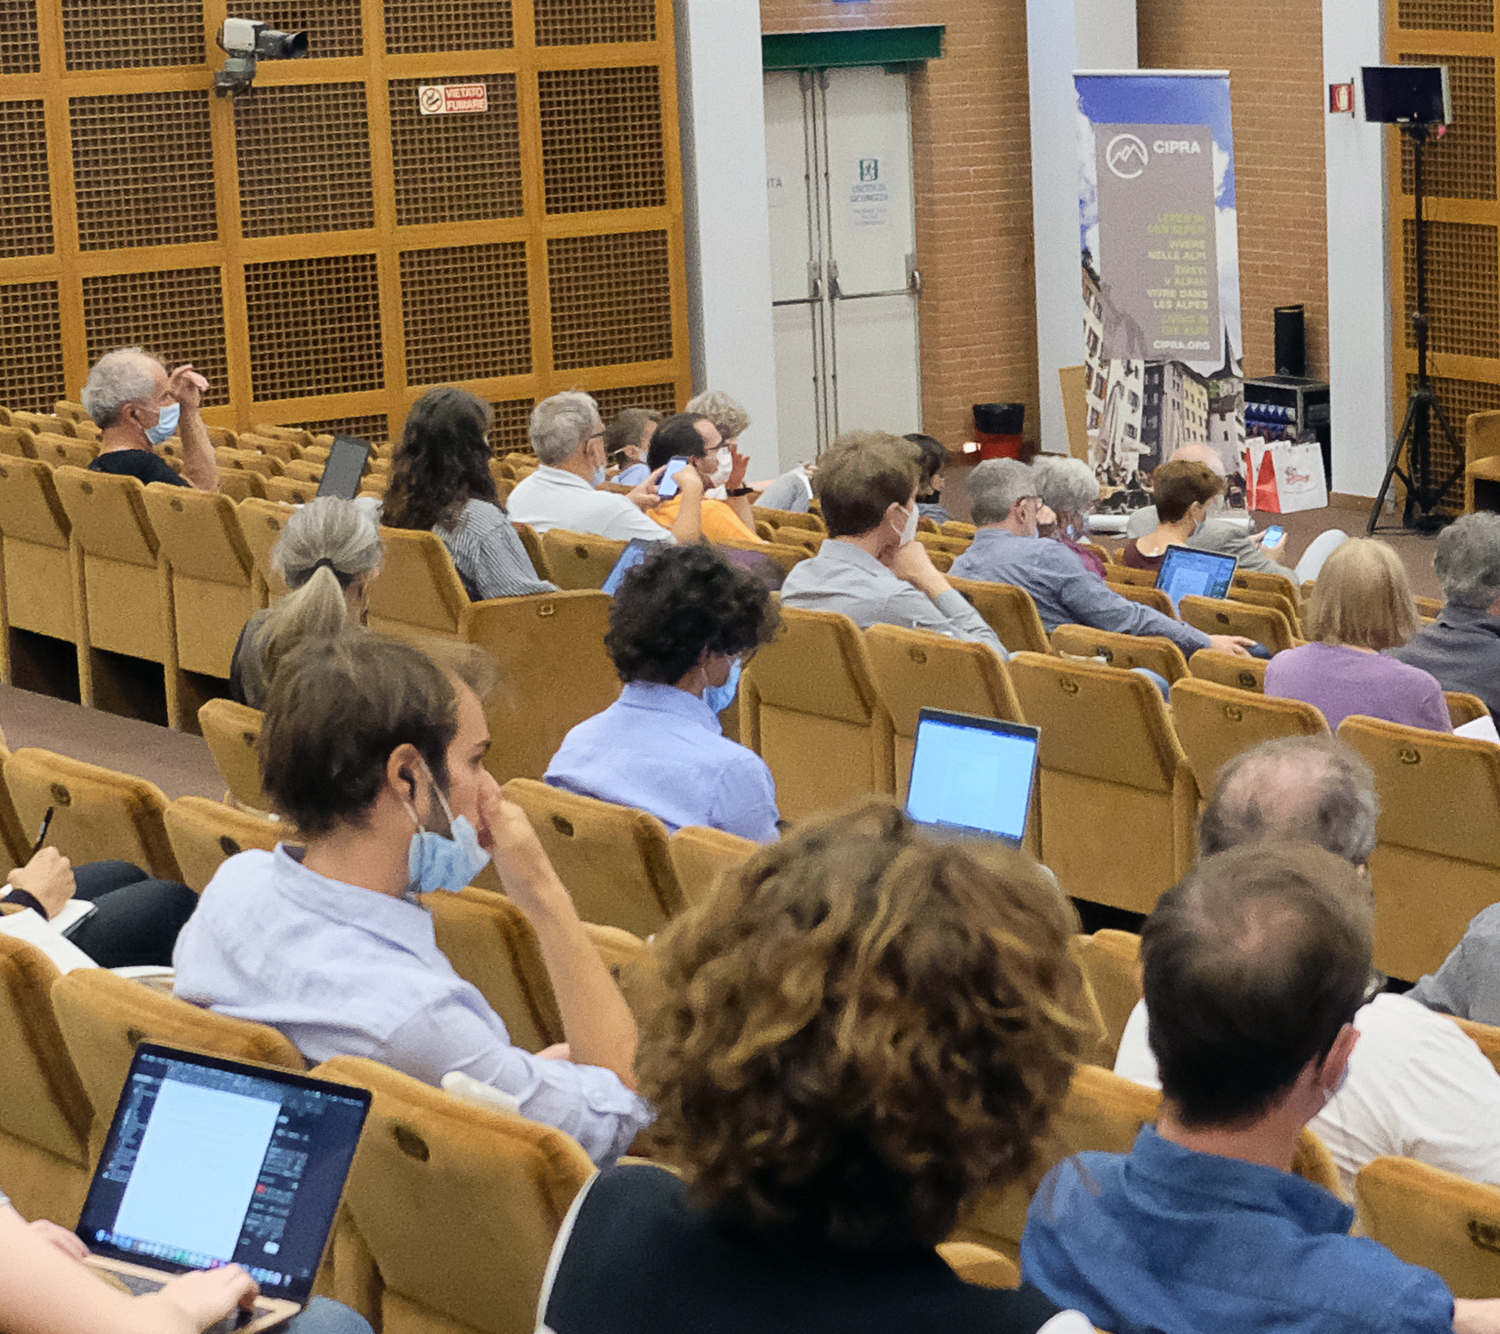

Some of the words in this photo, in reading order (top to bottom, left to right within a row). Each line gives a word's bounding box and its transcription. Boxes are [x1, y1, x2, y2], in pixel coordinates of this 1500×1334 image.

[1153, 140, 1201, 154] CIPRA
[767, 178, 782, 188] ITA
[1153, 339, 1211, 351] CIPRA.ORG
